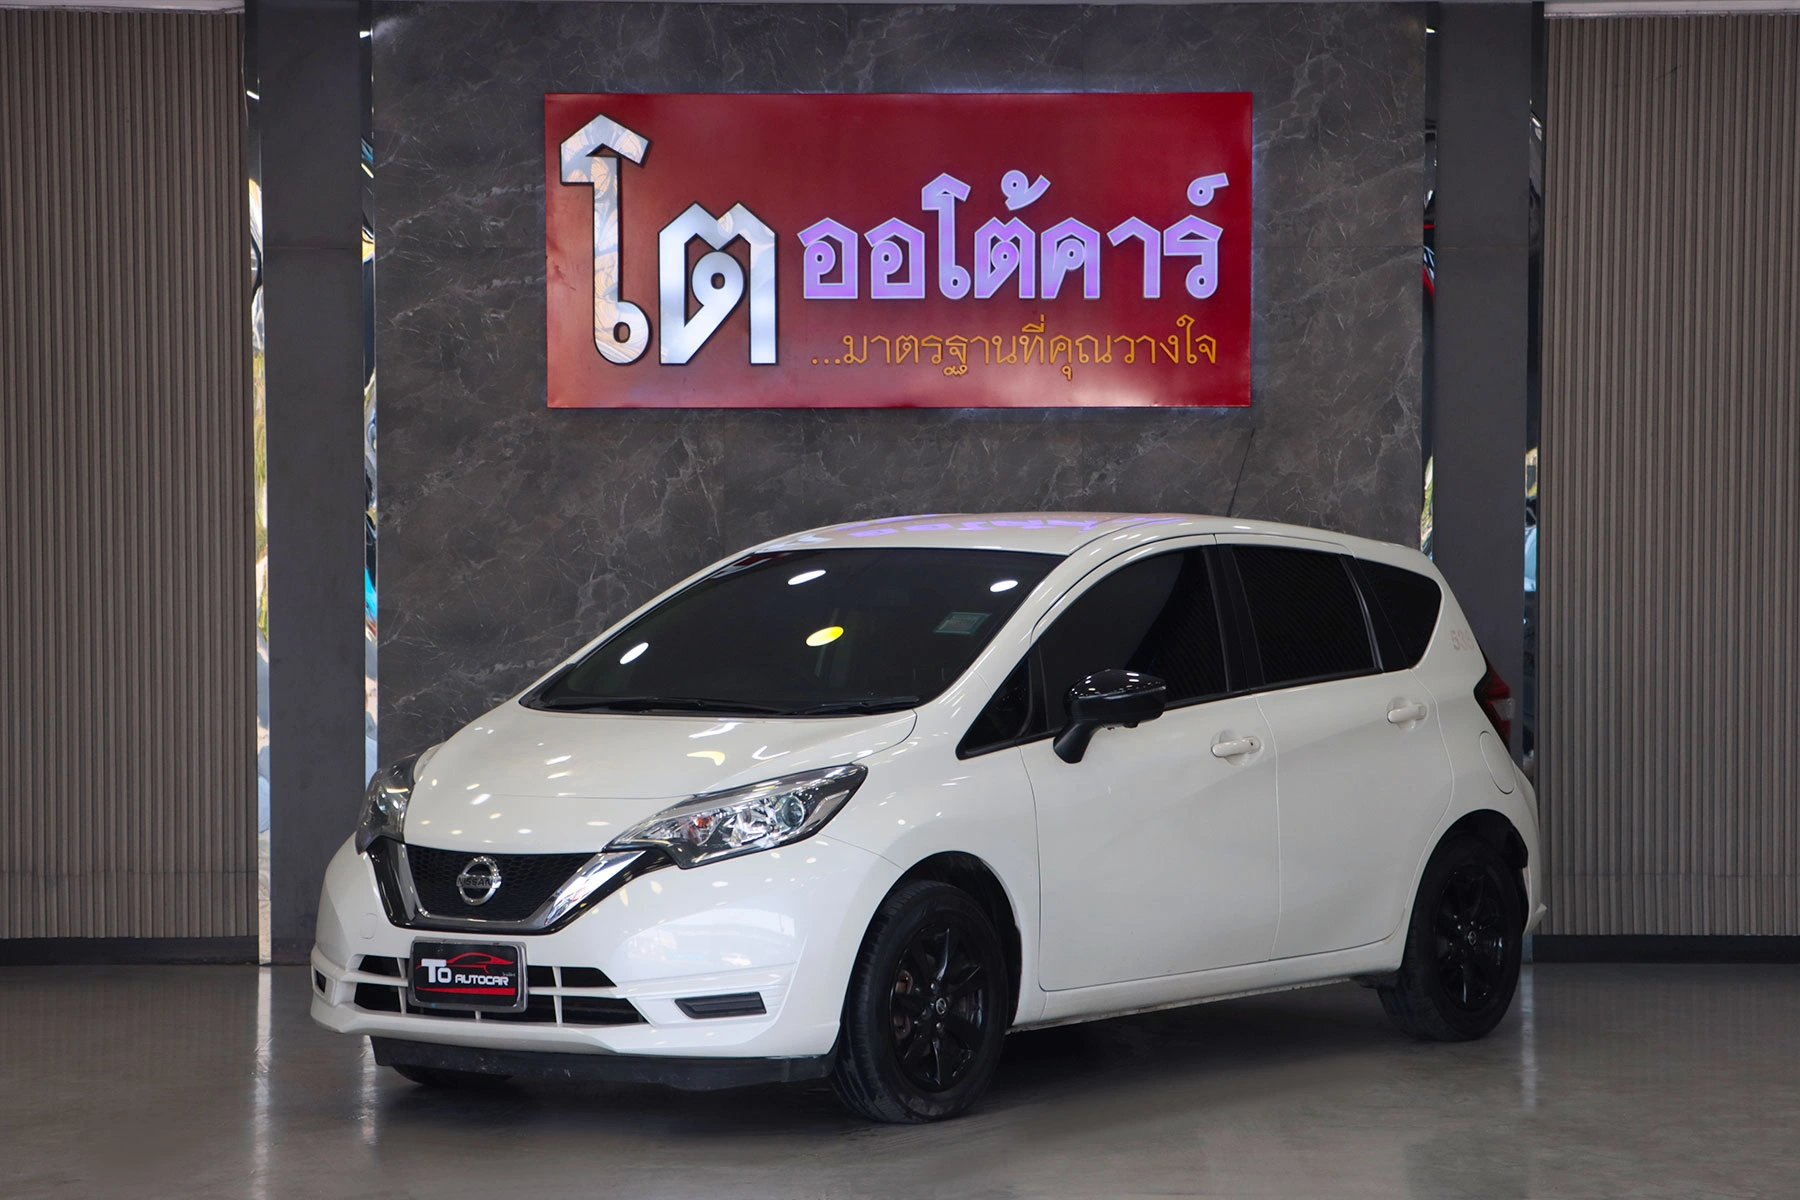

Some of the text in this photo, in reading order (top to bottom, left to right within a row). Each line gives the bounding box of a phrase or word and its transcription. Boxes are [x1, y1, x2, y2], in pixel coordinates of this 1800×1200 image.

[560, 114, 1230, 366] โต ออโต้คาร์
[458, 876, 493, 887] NISSAN
[455, 973, 510, 986] AUTOCAR
